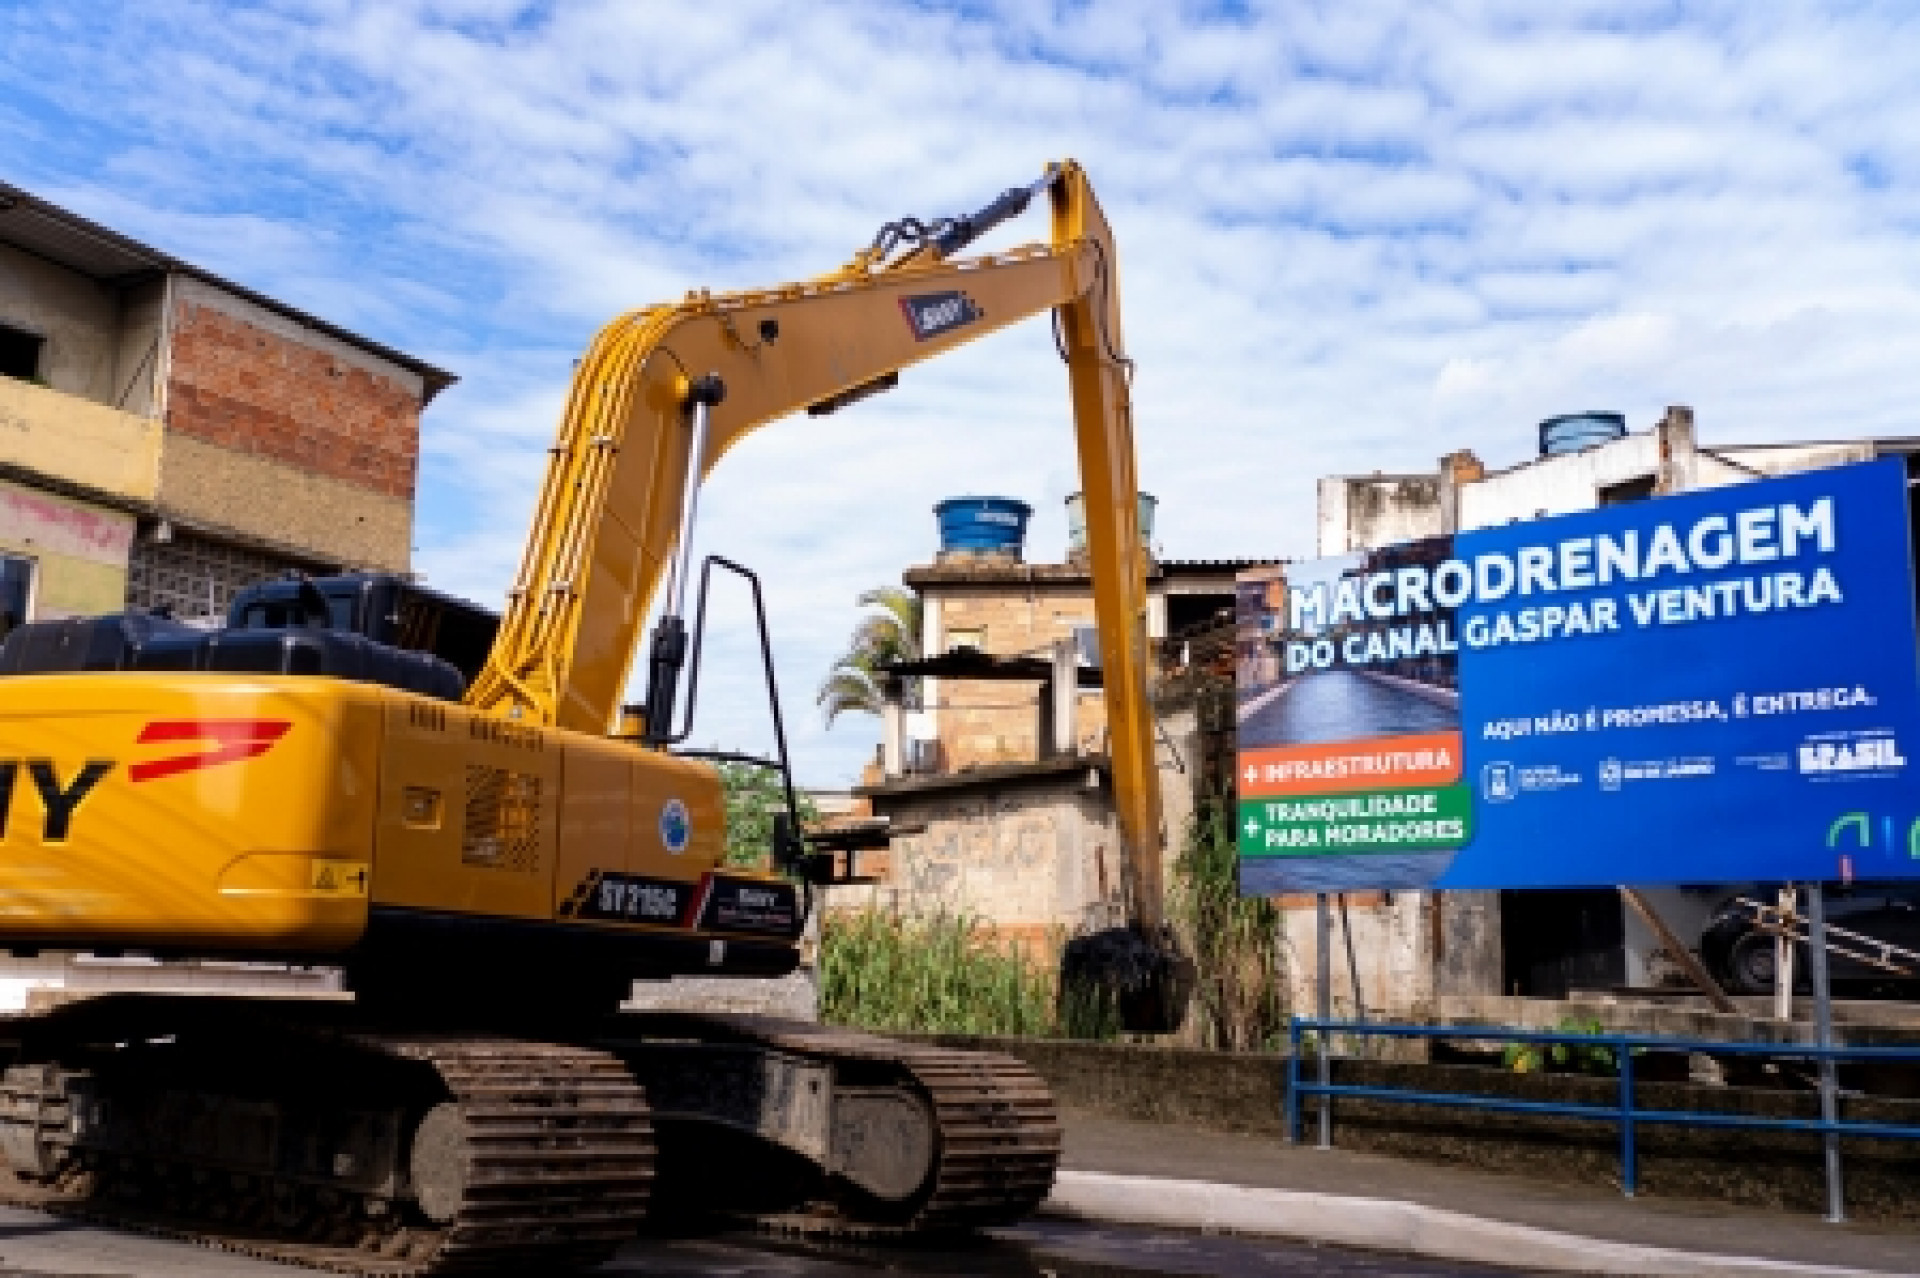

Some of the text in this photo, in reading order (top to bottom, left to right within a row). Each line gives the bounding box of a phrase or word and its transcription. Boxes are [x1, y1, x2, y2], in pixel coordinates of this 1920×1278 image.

[1289, 496, 1836, 632] MACRODRENAGEM
[1286, 566, 1844, 672] DO CANAL GASPAR VENTURA
[1483, 717, 1532, 741] AQUI
[1534, 708, 1580, 736] NÃO
[1585, 704, 1599, 730] É
[1602, 699, 1729, 729] PROMESSA,
[1733, 691, 1750, 719] É
[1262, 747, 1456, 784] INFRAESTRUTURA
[1264, 790, 1438, 826] TRANQUILIDADE
[1264, 816, 1465, 851] PARA MORADORES
